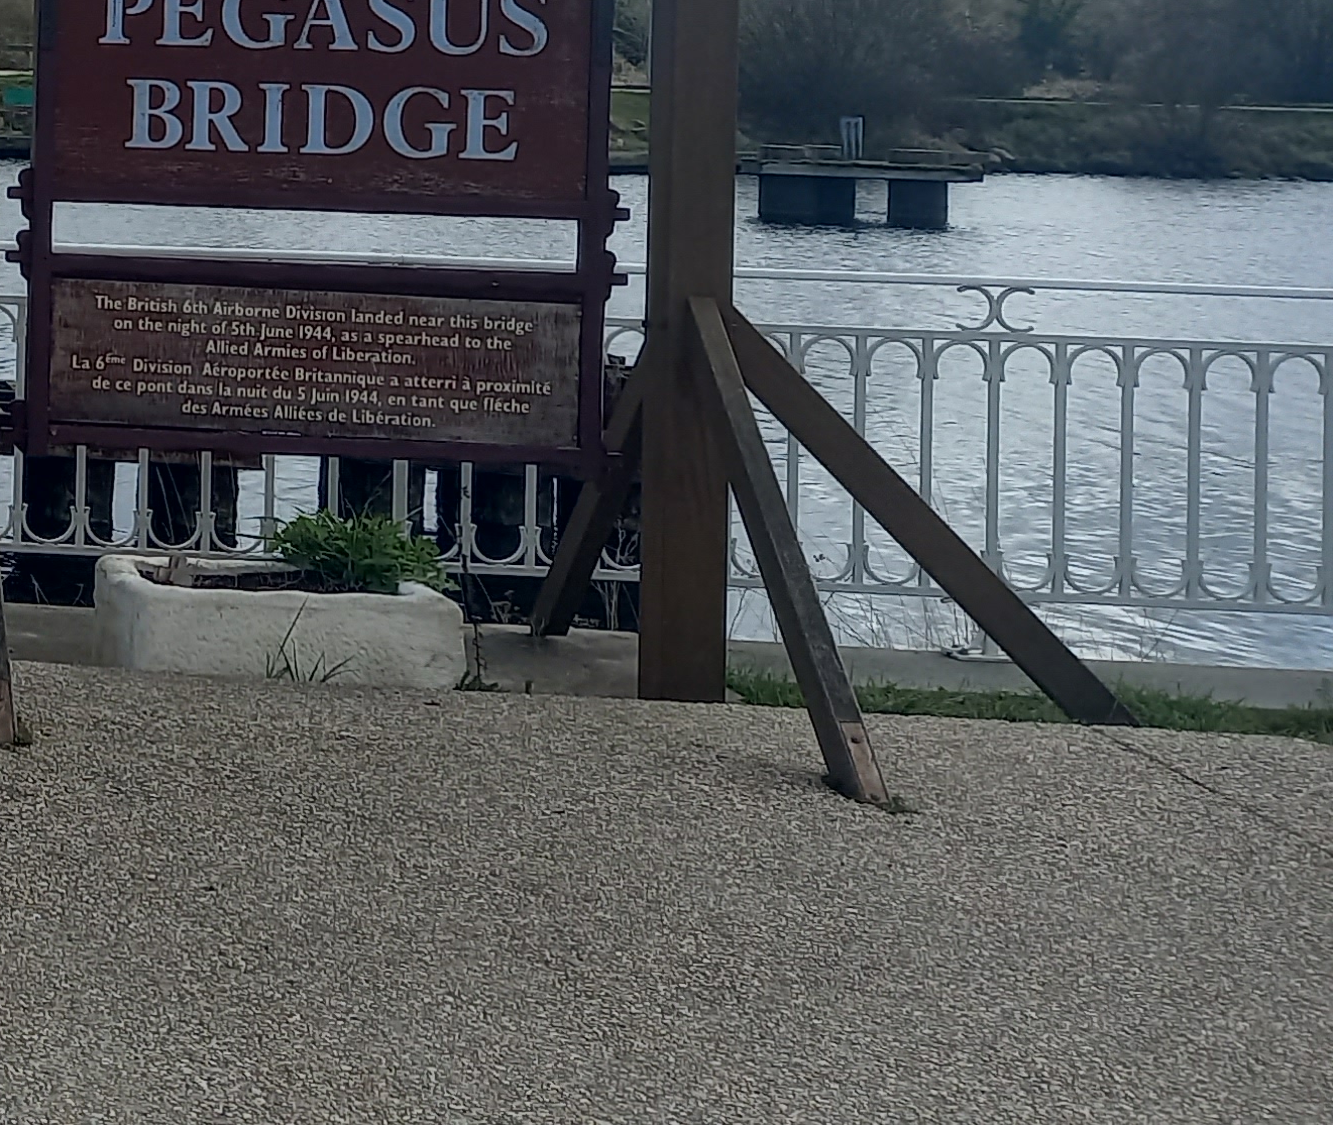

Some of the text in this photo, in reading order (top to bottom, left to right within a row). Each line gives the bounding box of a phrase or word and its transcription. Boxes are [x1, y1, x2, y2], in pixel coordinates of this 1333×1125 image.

[124, 78, 519, 161] BRIDGE
[95, 295, 533, 336] The British 6th Airborne Division landed near this bridge
[114, 317, 512, 350] on the night of 5th June 1944, as a spearhead to the
[205, 340, 416, 365] Allied Armies of Liberation.
[72, 355, 90, 370] La
[133, 358, 192, 375] Division
[202, 362, 289, 381] Aéroportée
[295, 367, 385, 388] Britannique
[390, 375, 399, 386] a
[404, 375, 457, 390] atterri
[462, 375, 471, 391] à
[92, 376, 110, 390] de
[115, 380, 132, 391] ce
[137, 381, 173, 395] pont
[178, 380, 213, 396] dans
[219, 382, 231, 396] la
[237, 384, 267, 398] nuit
[272, 385, 292, 400] du
[298, 388, 305, 401] 5
[311, 388, 340, 405] Juin
[345, 389, 382, 407] 1944,
[388, 395, 406, 406] en
[412, 394, 444, 409] tant
[450, 398, 478, 413] que
[182, 400, 436, 428] des Armées Alliées de Libération.
